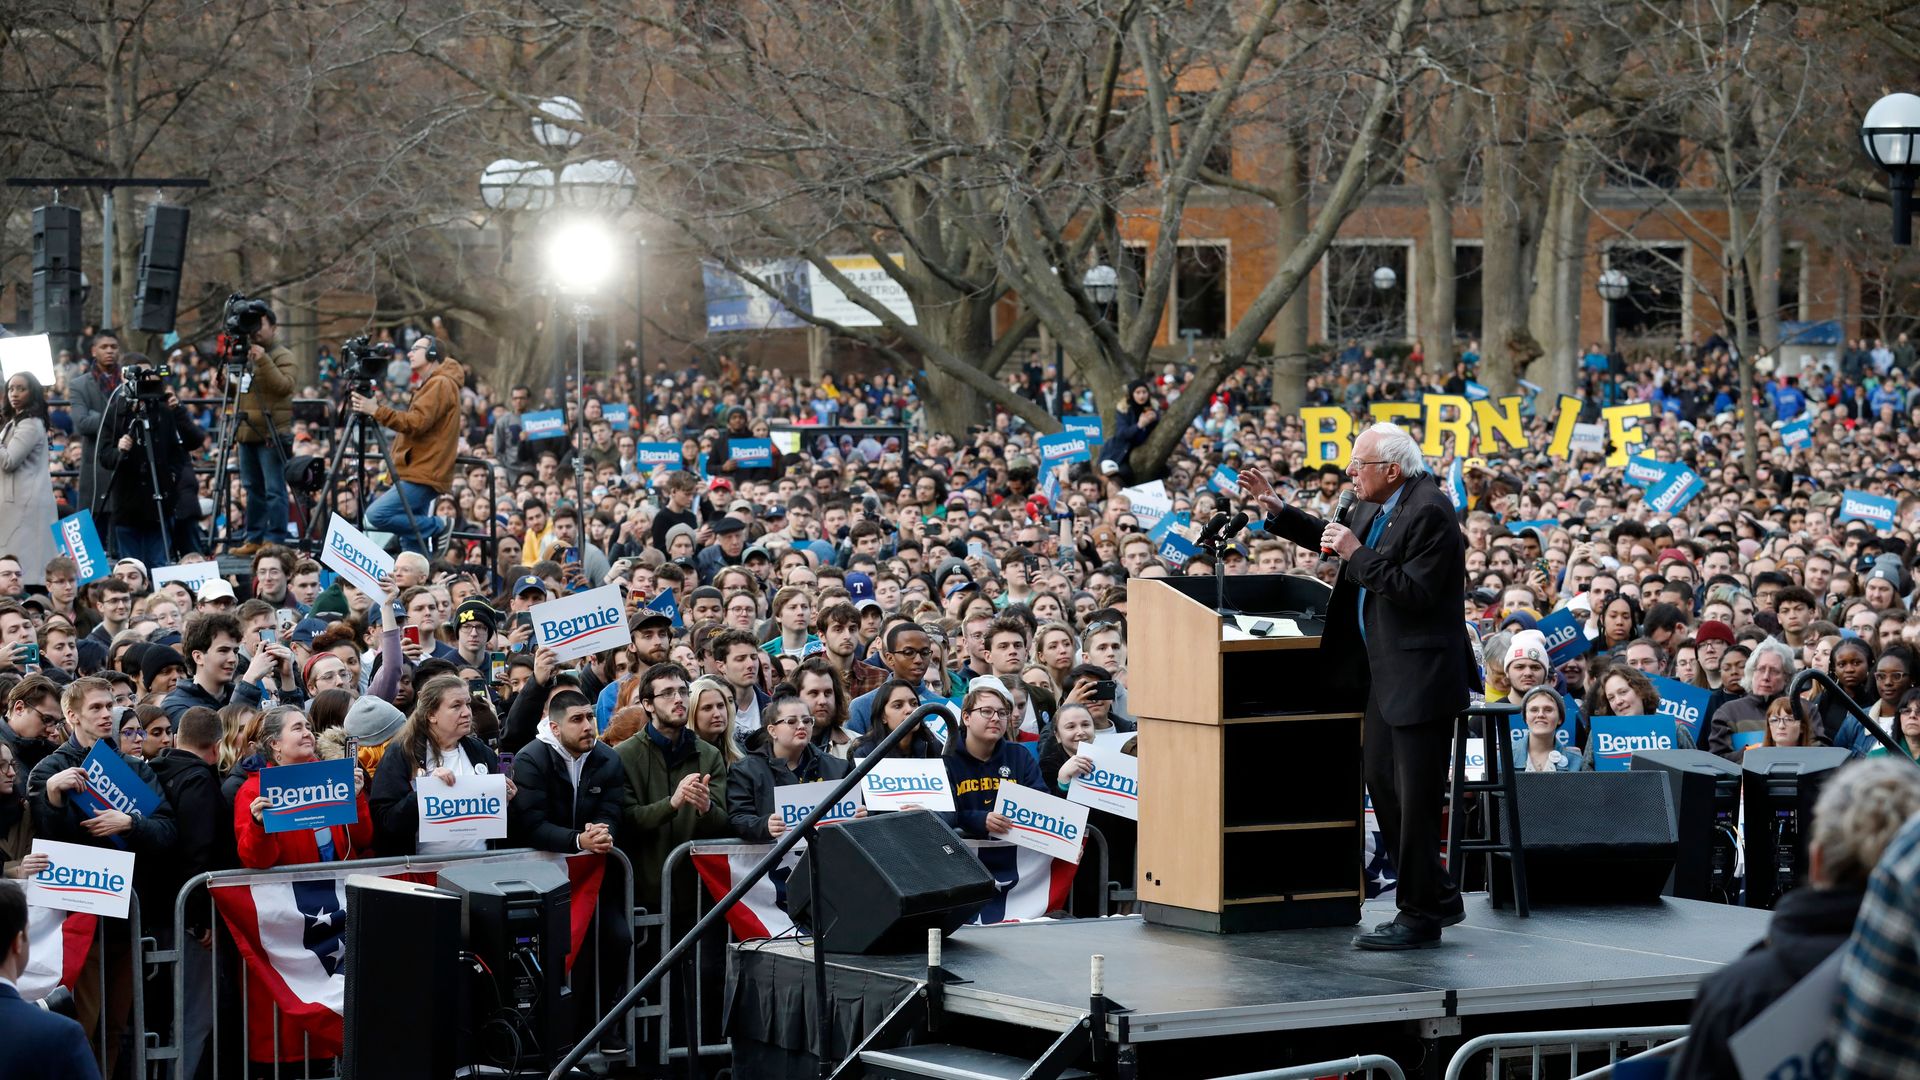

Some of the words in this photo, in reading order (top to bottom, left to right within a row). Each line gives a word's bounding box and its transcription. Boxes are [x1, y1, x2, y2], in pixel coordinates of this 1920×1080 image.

[525, 417, 561, 429] Bernie
[640, 450, 679, 461] Bernie
[732, 446, 769, 458] Bernie
[1043, 439, 1085, 456] Bernie
[1652, 471, 1693, 512] Bernie
[1132, 503, 1166, 518] ernie
[1845, 500, 1892, 519] Bernie
[64, 518, 94, 578] Bernie
[332, 530, 388, 582] Bernie
[1162, 543, 1190, 564] Ber
[854, 582, 863, 593] T
[460, 609, 474, 623] M
[540, 606, 620, 641] Bernie
[1545, 624, 1577, 650] nie
[1656, 698, 1699, 723] rnie
[1597, 731, 1671, 751] Bernie
[867, 773, 944, 791] Bernie
[1078, 763, 1137, 796] Bern
[266, 778, 349, 807] Bernie
[424, 792, 500, 818] Bernie
[1002, 799, 1077, 840] Bernie
[36, 860, 124, 892] Bernie
